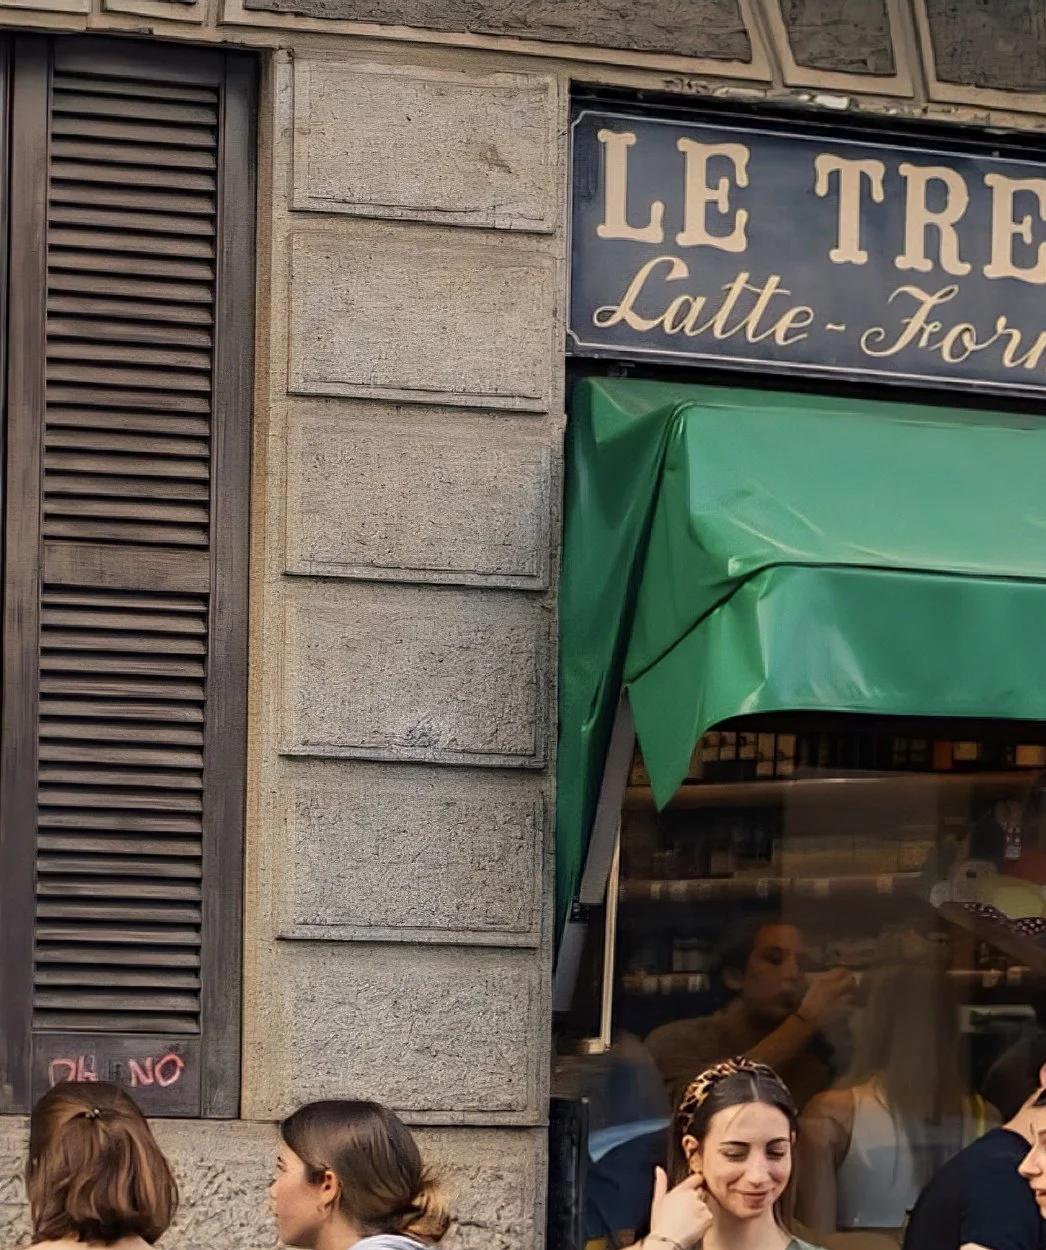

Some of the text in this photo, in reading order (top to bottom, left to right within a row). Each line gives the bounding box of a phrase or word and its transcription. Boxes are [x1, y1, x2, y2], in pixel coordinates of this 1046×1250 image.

[597, 129, 750, 252] LE
[593, 256, 814, 346] Latte
[128, 1053, 184, 1087] NO
